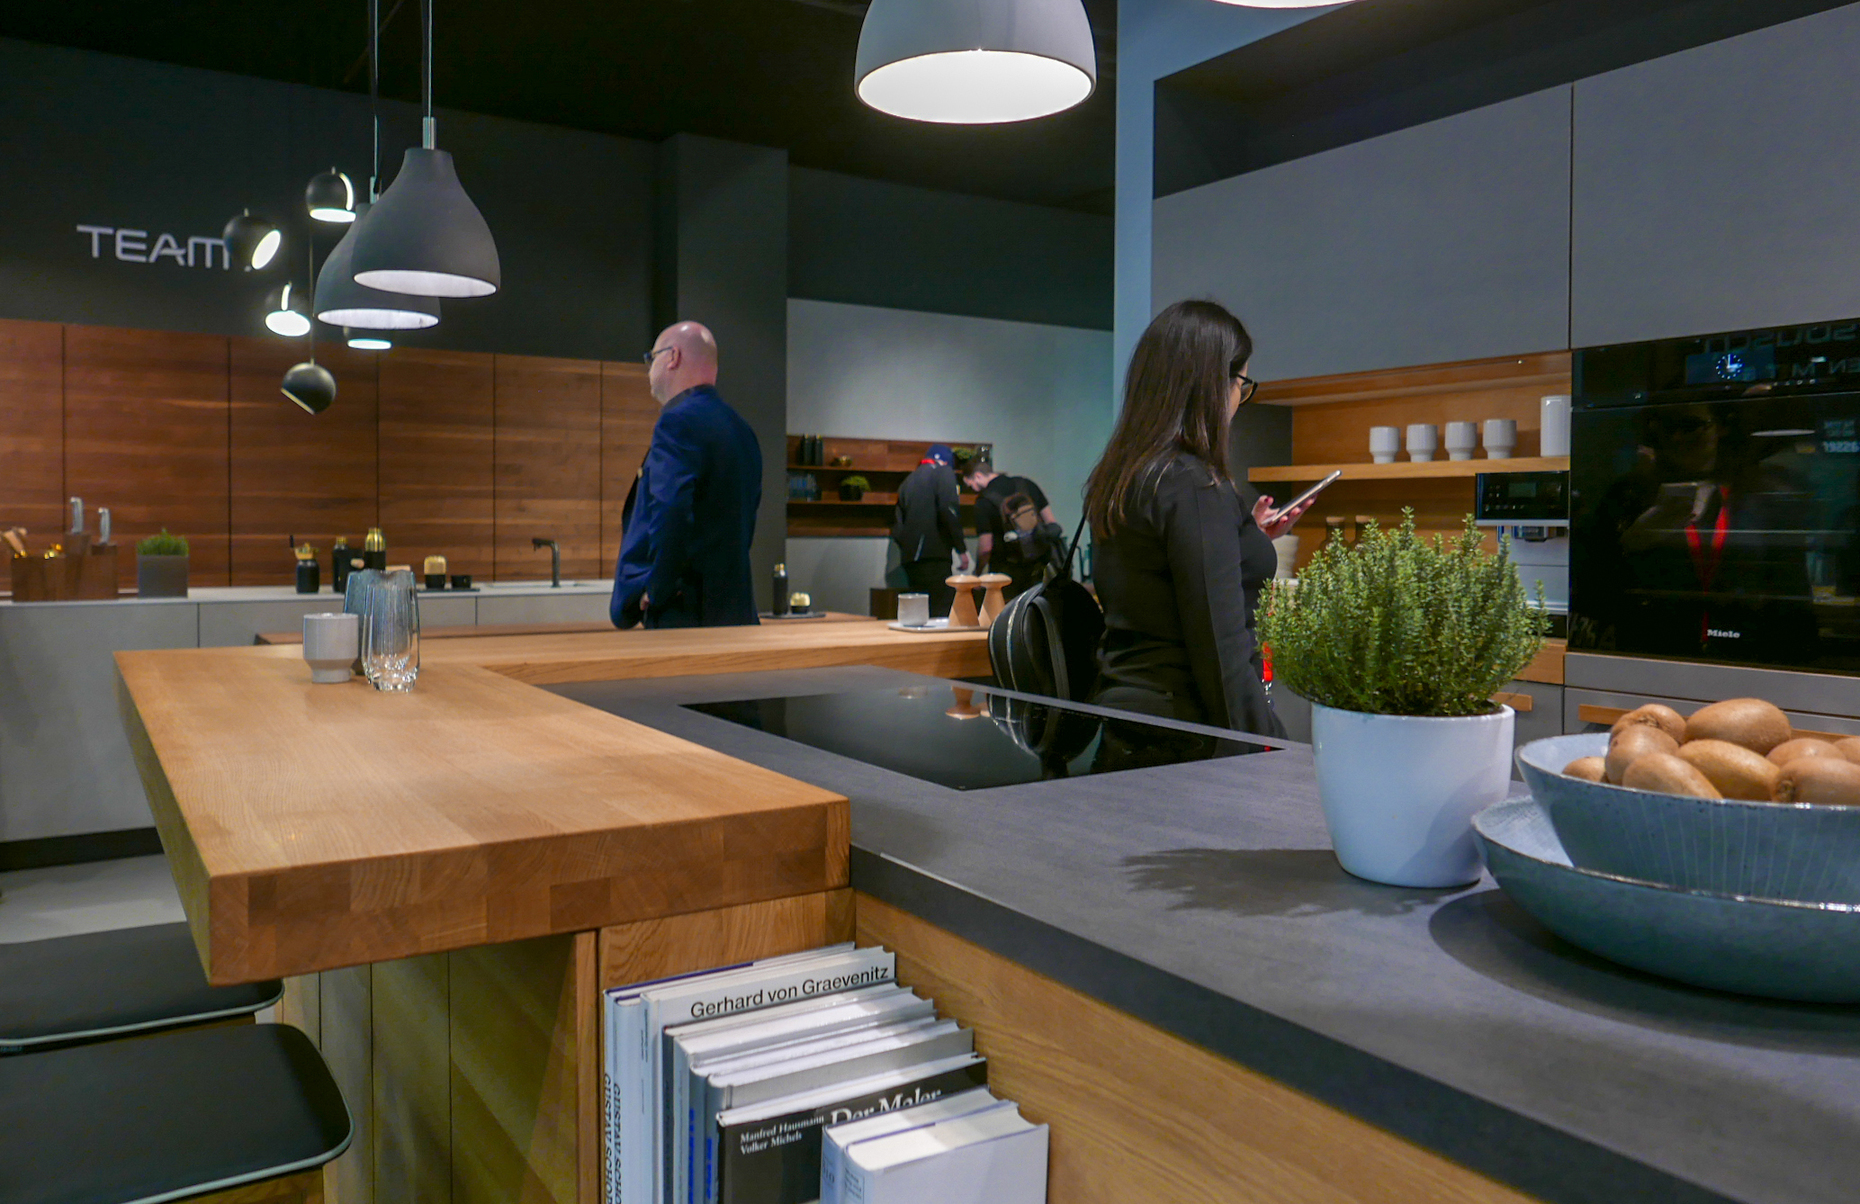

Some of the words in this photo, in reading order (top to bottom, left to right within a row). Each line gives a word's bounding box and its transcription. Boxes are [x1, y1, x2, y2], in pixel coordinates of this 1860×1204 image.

[76, 224, 229, 271] TEAM
[1707, 629, 1740, 639] Miele
[691, 989, 763, 1018] Gerhard
[768, 985, 798, 1002] von
[802, 966, 889, 994] Graevenitz
[740, 1124, 777, 1144] Manfred
[779, 1115, 825, 1134] Hausmann
[740, 1141, 769, 1155] Volker
[771, 1130, 803, 1147] Michels
